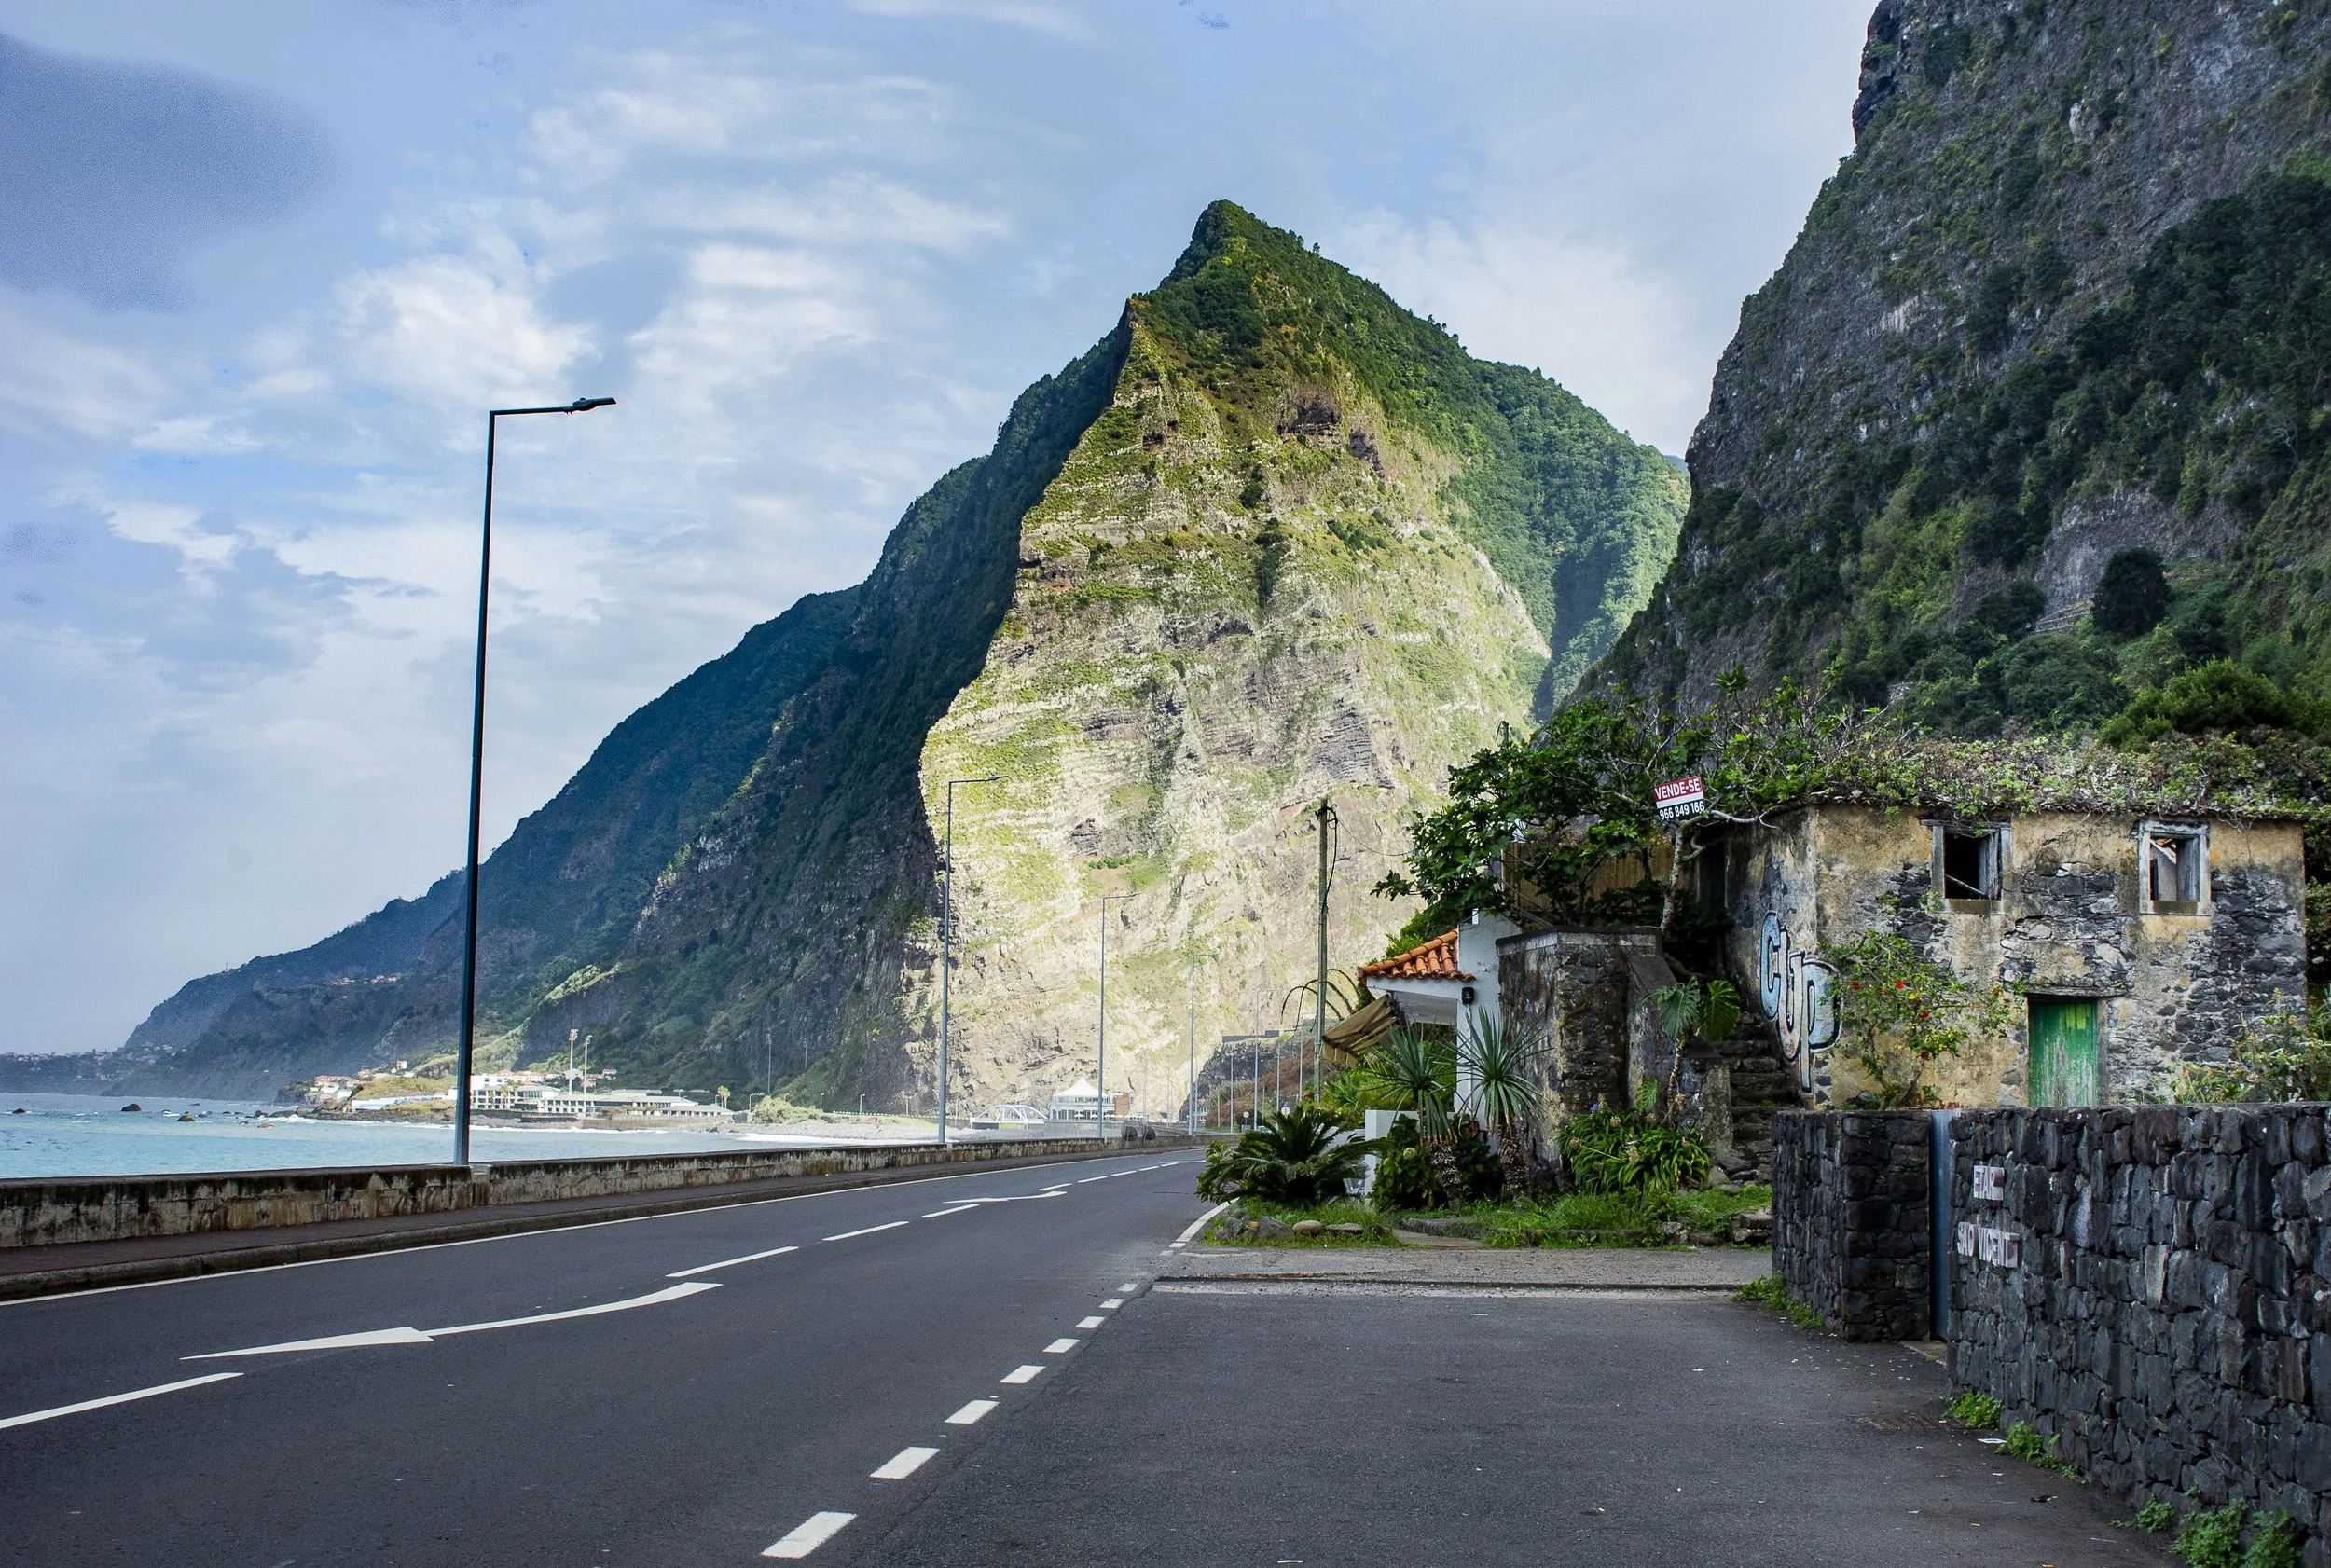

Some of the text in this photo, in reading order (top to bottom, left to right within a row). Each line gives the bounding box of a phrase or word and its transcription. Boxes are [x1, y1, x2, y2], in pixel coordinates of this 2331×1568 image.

[1655, 778, 1701, 800] VENDE-SE
[1660, 801, 1705, 820] 966 849 166
